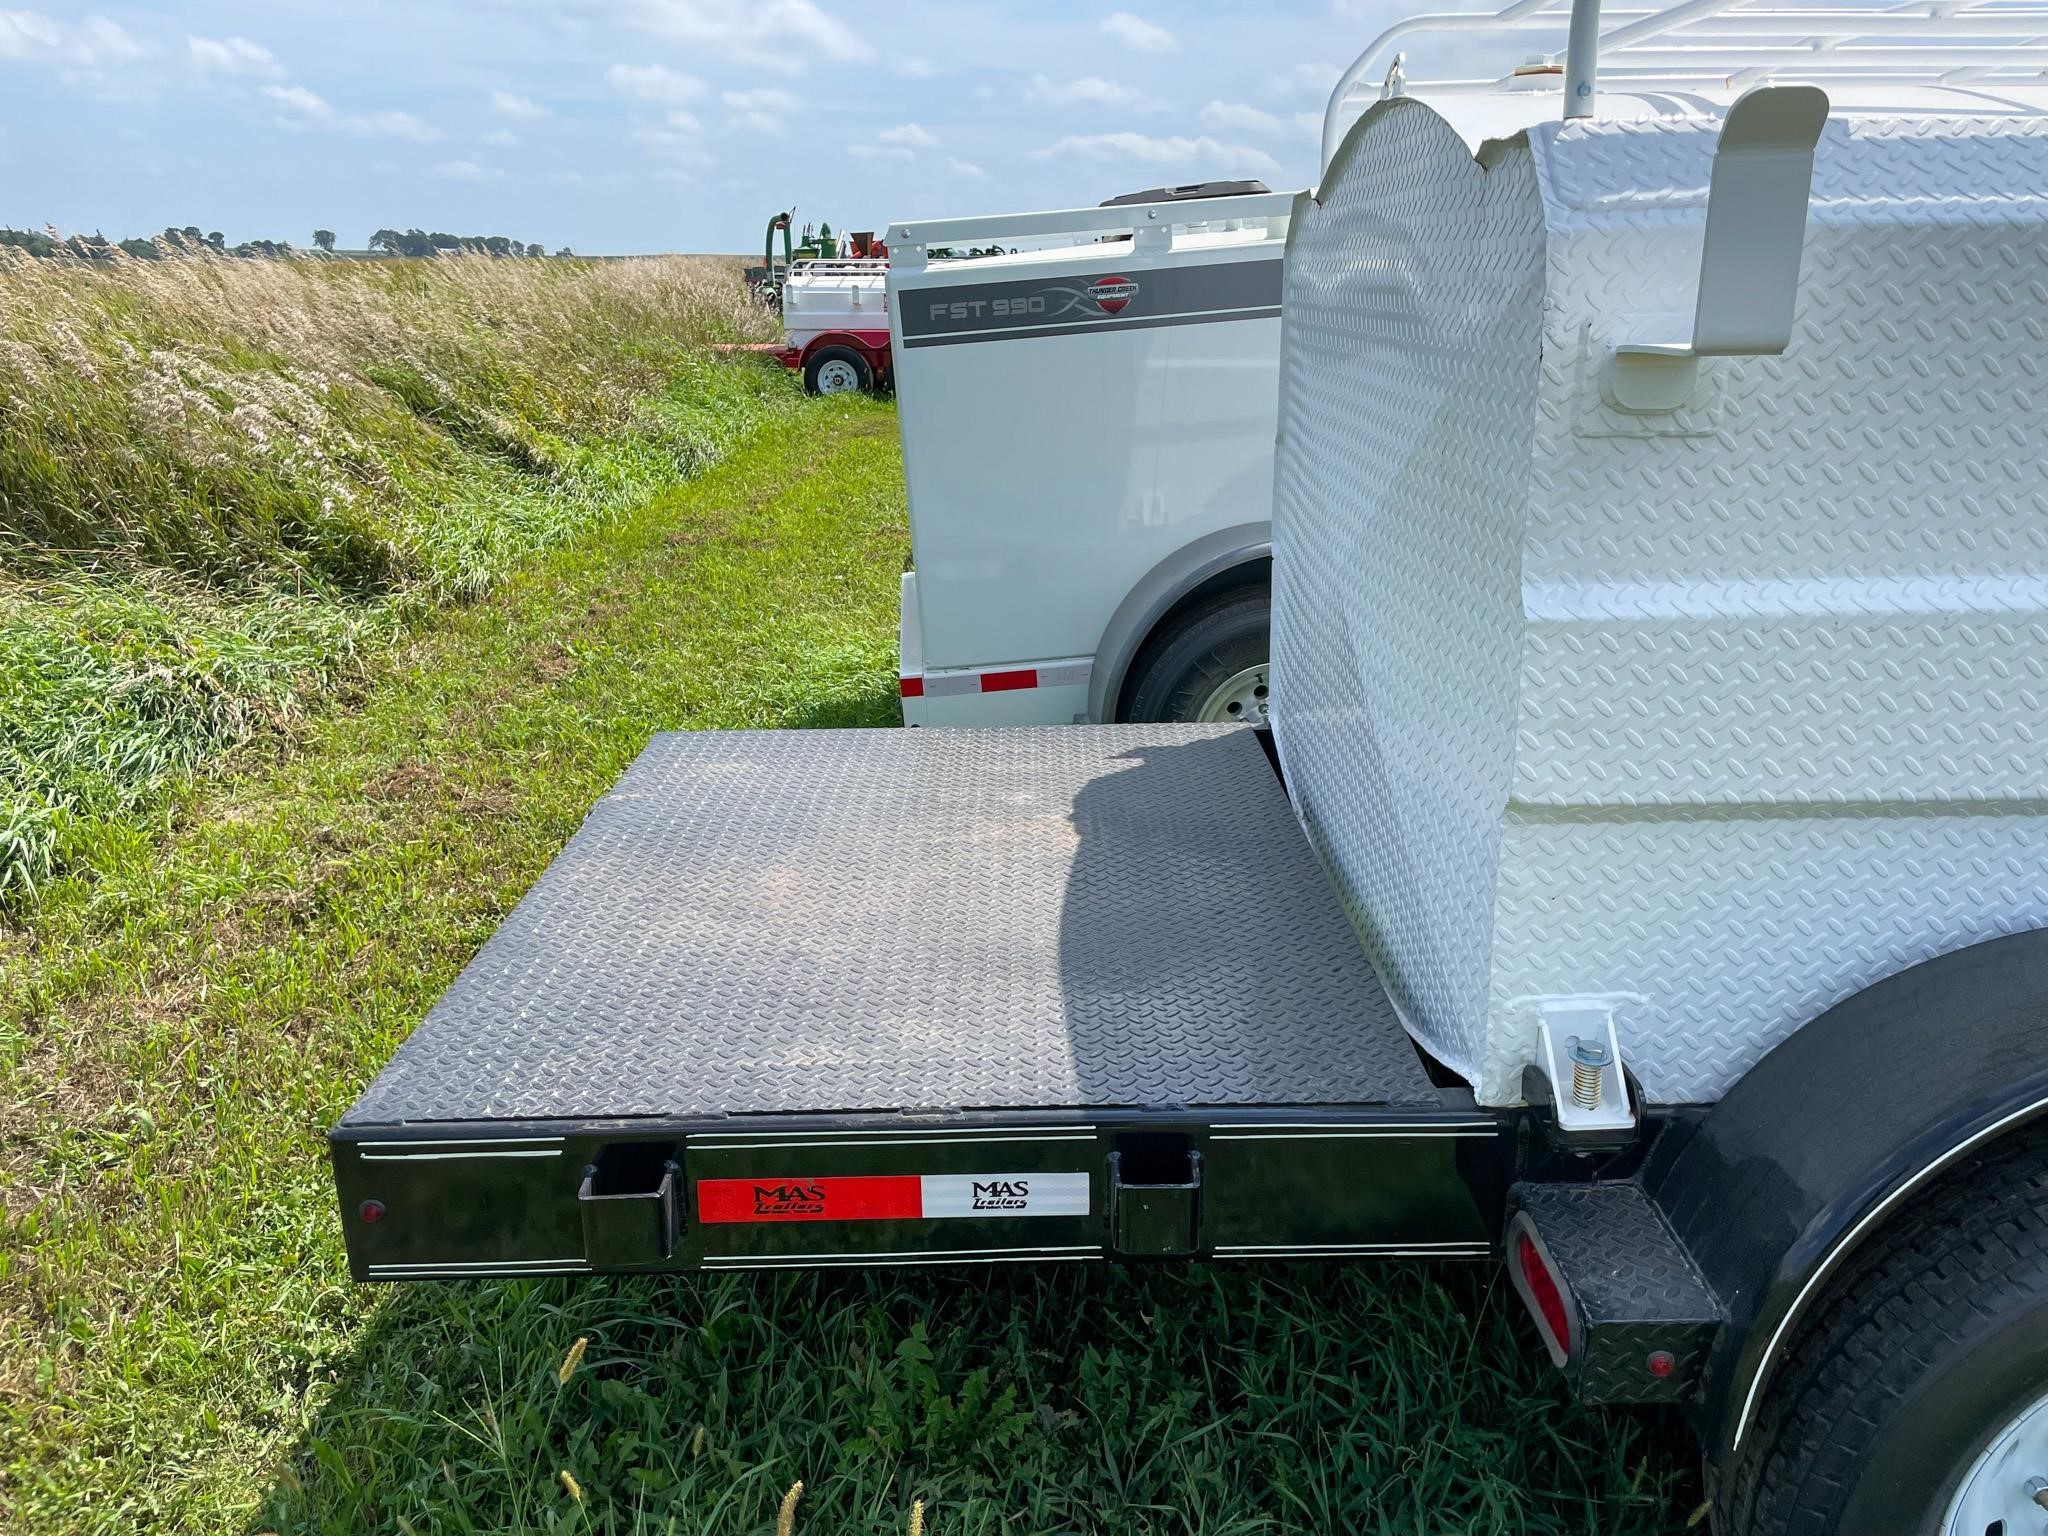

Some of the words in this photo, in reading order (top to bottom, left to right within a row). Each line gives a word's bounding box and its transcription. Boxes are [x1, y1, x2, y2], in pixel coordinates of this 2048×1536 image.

[1089, 286, 1117, 295] THUNDER
[929, 300, 987, 321] FST
[991, 296, 1046, 316] 990
[753, 1184, 826, 1202] MAS
[970, 1180, 1029, 1198] MAS
[752, 1202, 825, 1215] Trailers
[971, 1197, 1028, 1210] Trailers
